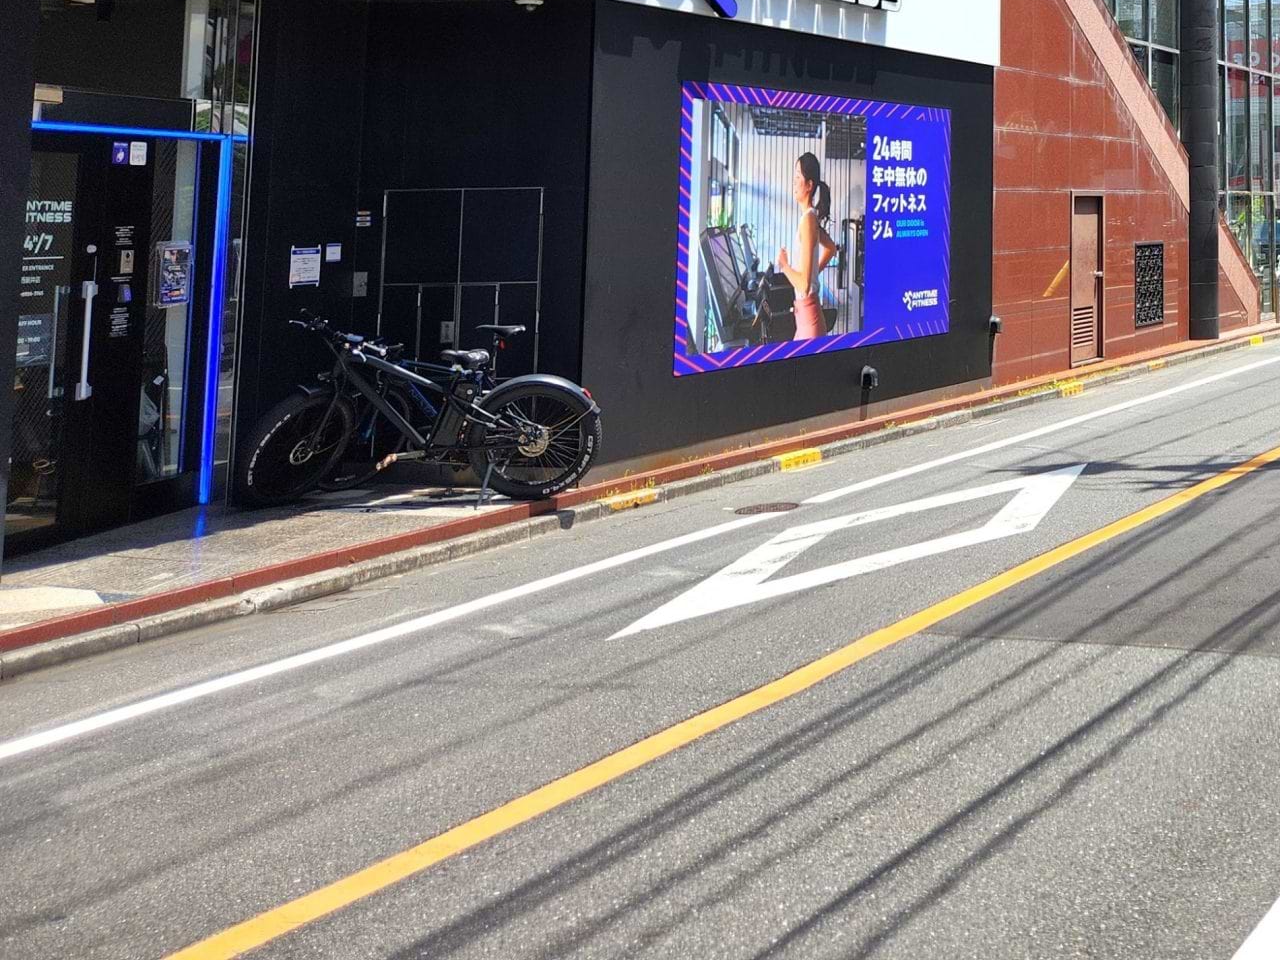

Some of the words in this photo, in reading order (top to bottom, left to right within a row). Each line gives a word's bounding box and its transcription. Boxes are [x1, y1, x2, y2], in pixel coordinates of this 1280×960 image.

[872, 135, 913, 161] 24時間
[872, 166, 928, 188] 年中無休の
[26, 200, 73, 212] NYTIME
[872, 194, 928, 213] フィットネス
[25, 212, 72, 223] ITNESS
[872, 219, 894, 240] ジム
[912, 289, 938, 299] ANYTIME
[912, 298, 938, 308] FITNESS
